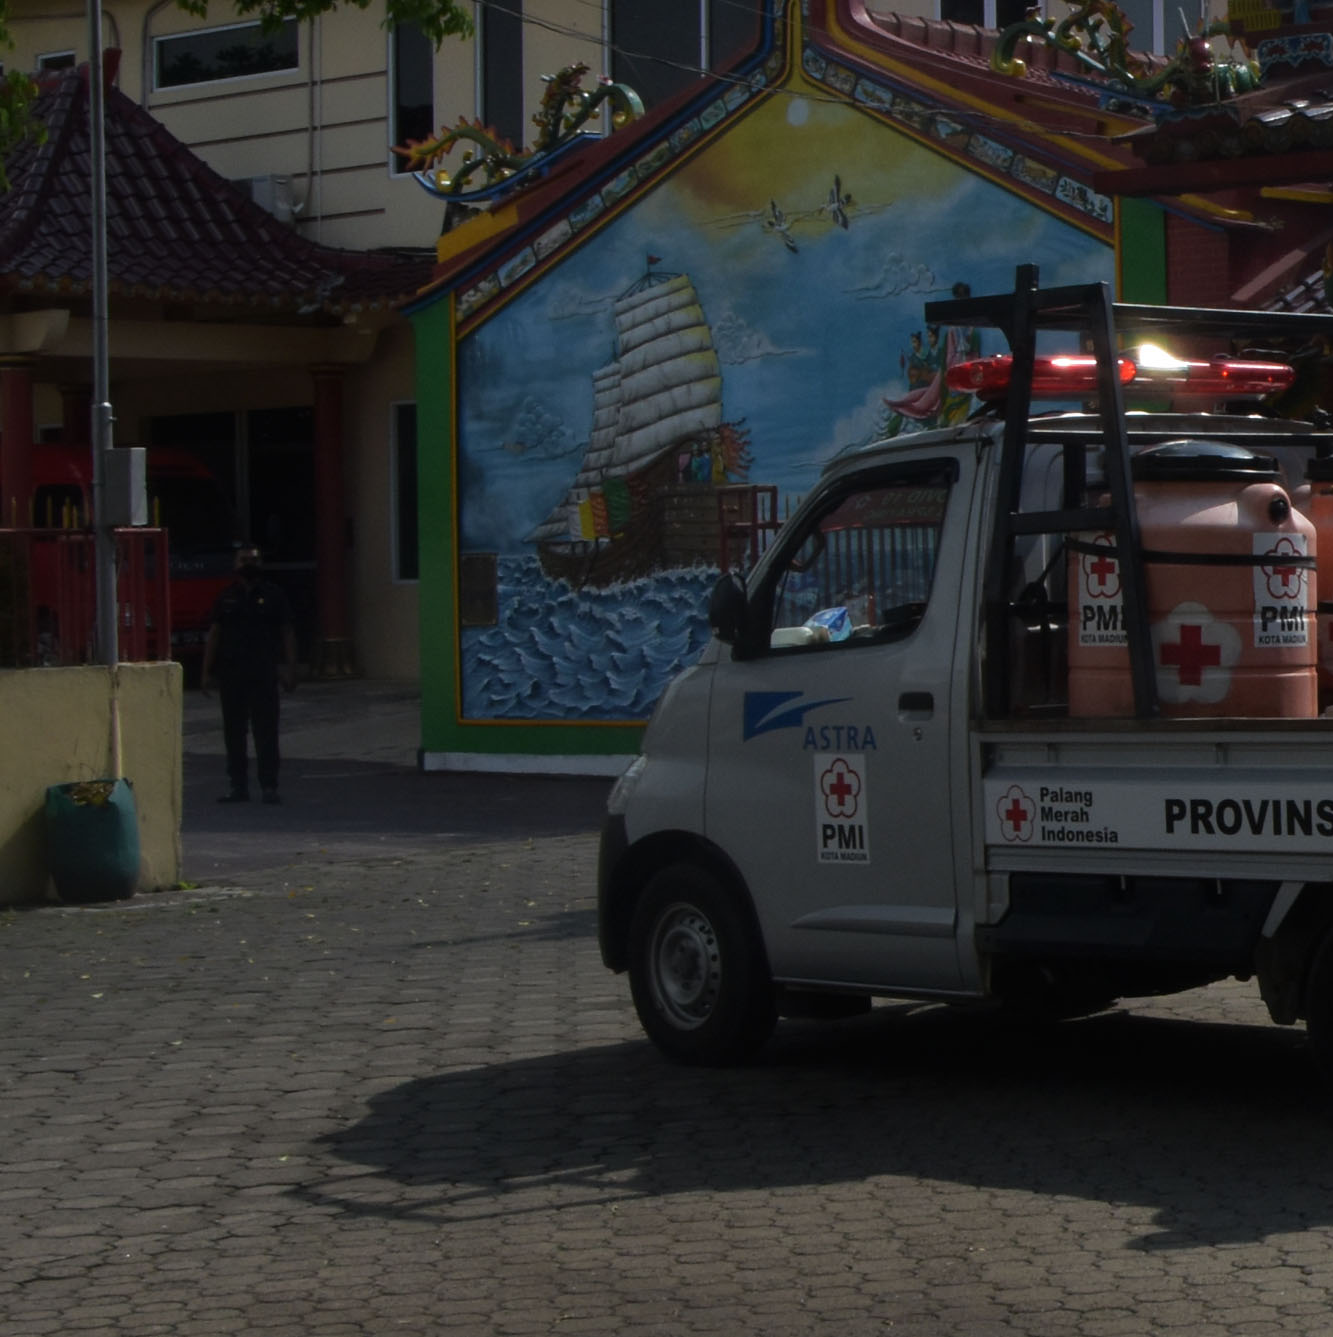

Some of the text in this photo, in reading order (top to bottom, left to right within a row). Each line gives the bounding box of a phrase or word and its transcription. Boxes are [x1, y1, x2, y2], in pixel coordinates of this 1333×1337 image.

[1261, 605, 1306, 632] PMI
[1258, 634, 1281, 645] KOTA
[802, 725, 878, 751] ASTRA
[1039, 786, 1094, 808] Palang
[1040, 806, 1090, 824] Merah
[822, 823, 865, 850] PMI
[1041, 826, 1119, 844] Indonesia
